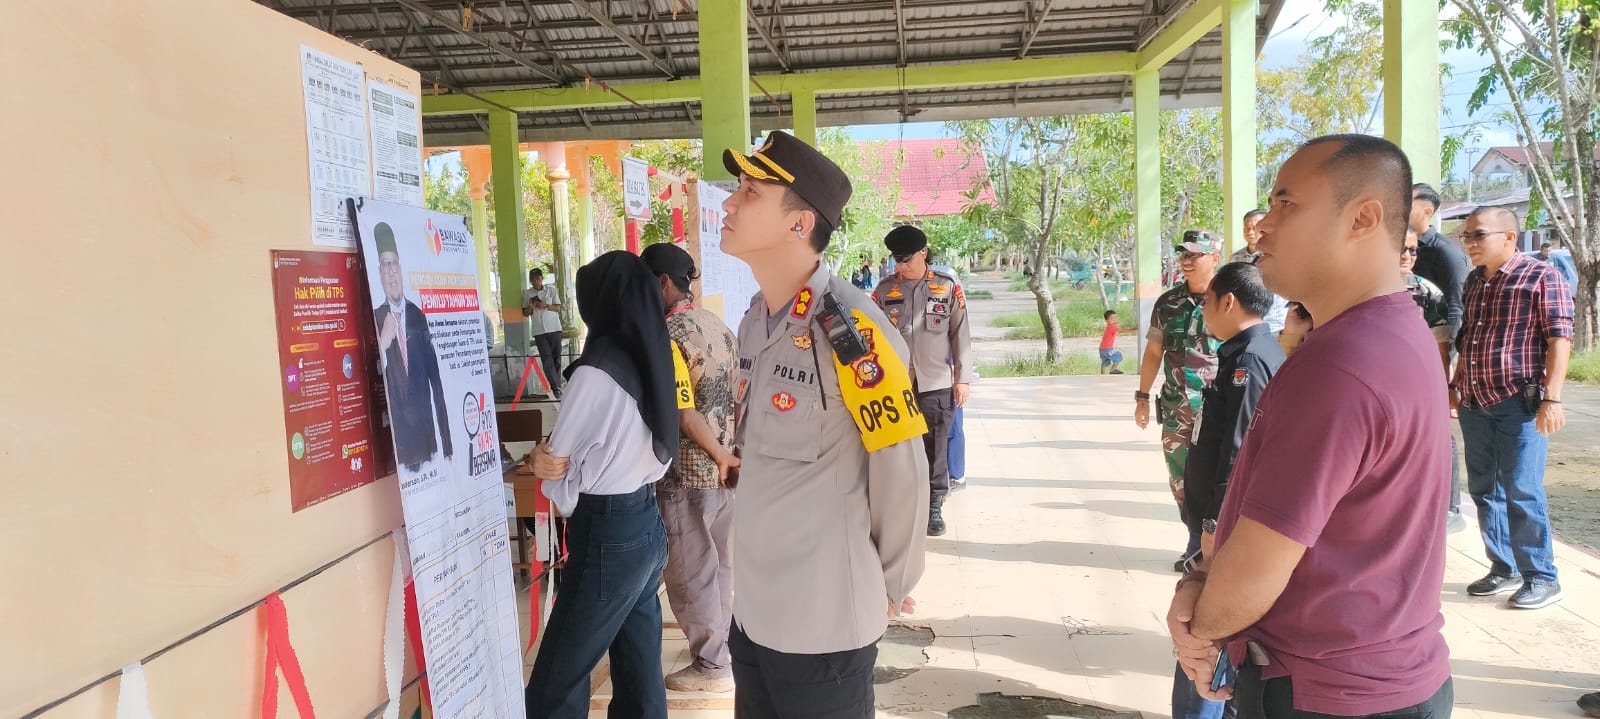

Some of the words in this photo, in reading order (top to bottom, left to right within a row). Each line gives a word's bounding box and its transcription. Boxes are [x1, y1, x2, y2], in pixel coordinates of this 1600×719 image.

[295, 287, 308, 300] Hak
[309, 286, 325, 299] Pilih
[332, 286, 344, 298] TPS
[421, 294, 445, 309] PEMILU
[773, 364, 814, 384] POLRI
[859, 395, 900, 433] OPS
